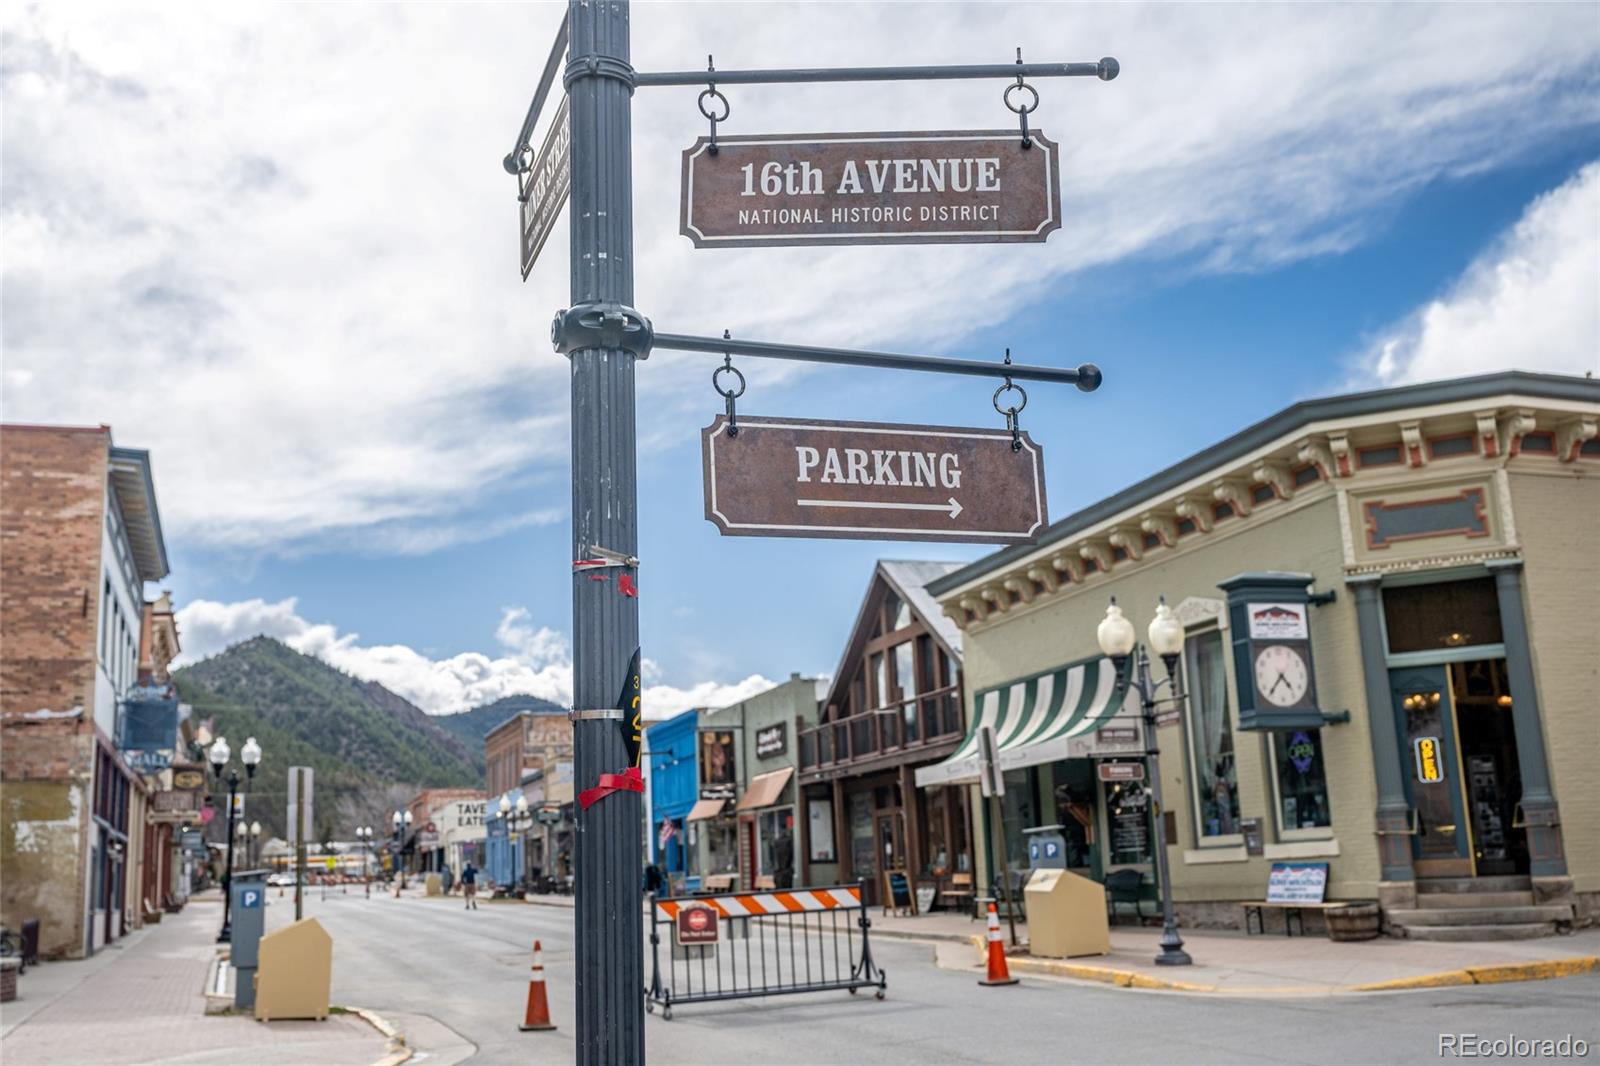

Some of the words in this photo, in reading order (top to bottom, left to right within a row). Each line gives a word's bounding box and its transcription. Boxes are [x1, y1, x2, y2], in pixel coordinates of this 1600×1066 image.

[546, 111, 570, 189] STREE
[740, 161, 825, 197] 16th
[836, 157, 1001, 195] AVENUE
[738, 208, 823, 225] NATIONAL
[831, 206, 913, 222] HISTORIC
[919, 204, 1000, 221] DISTRICT
[795, 446, 962, 489] PARKING
[633, 675, 640, 690] 3
[244, 891, 257, 907] P
